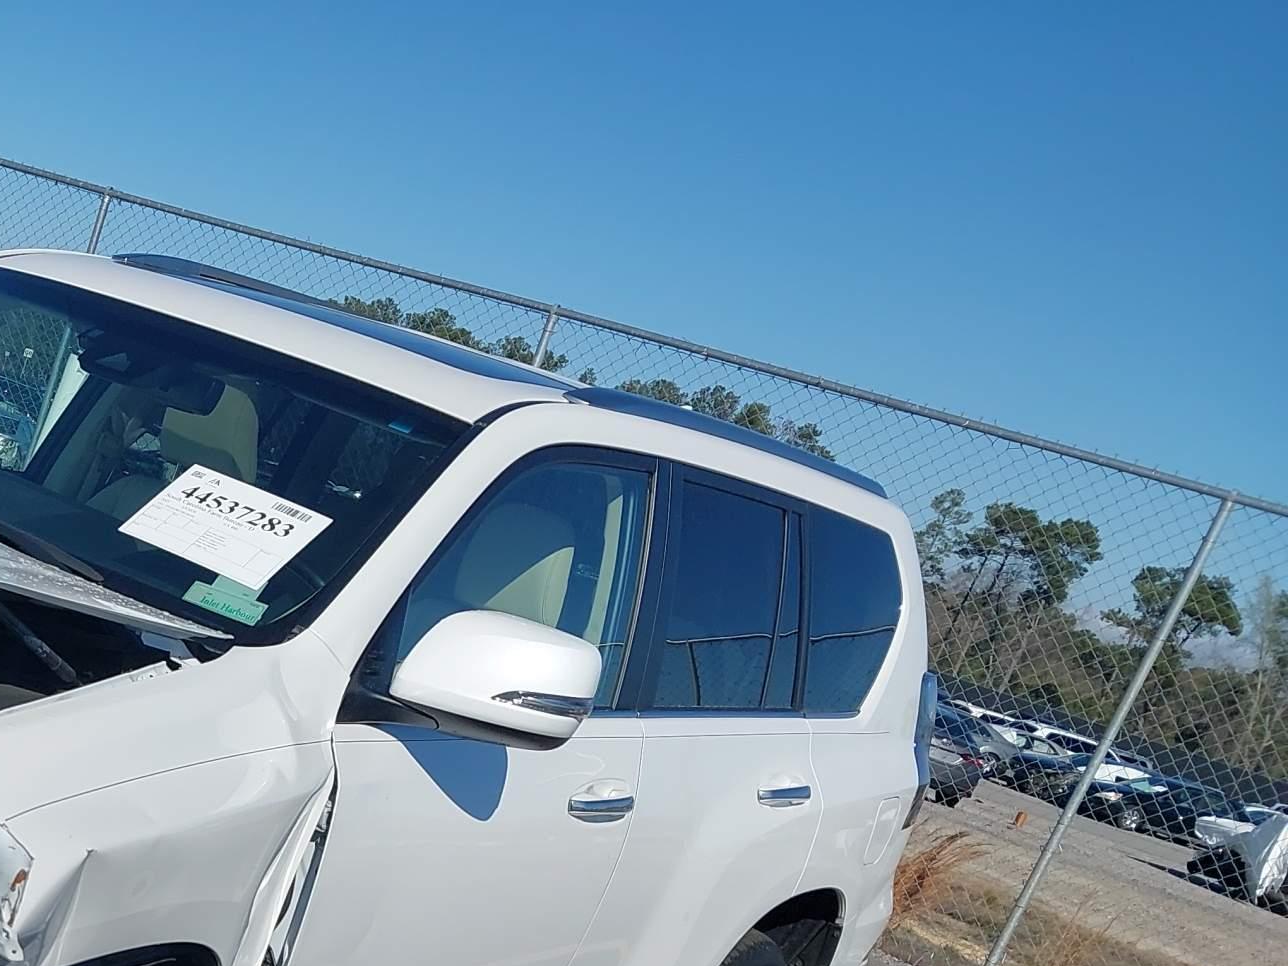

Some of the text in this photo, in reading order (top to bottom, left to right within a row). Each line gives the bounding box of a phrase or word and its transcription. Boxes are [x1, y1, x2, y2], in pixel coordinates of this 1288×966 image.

[181, 486, 295, 537] 44537283
[200, 596, 256, 621] Inlet Harbour
